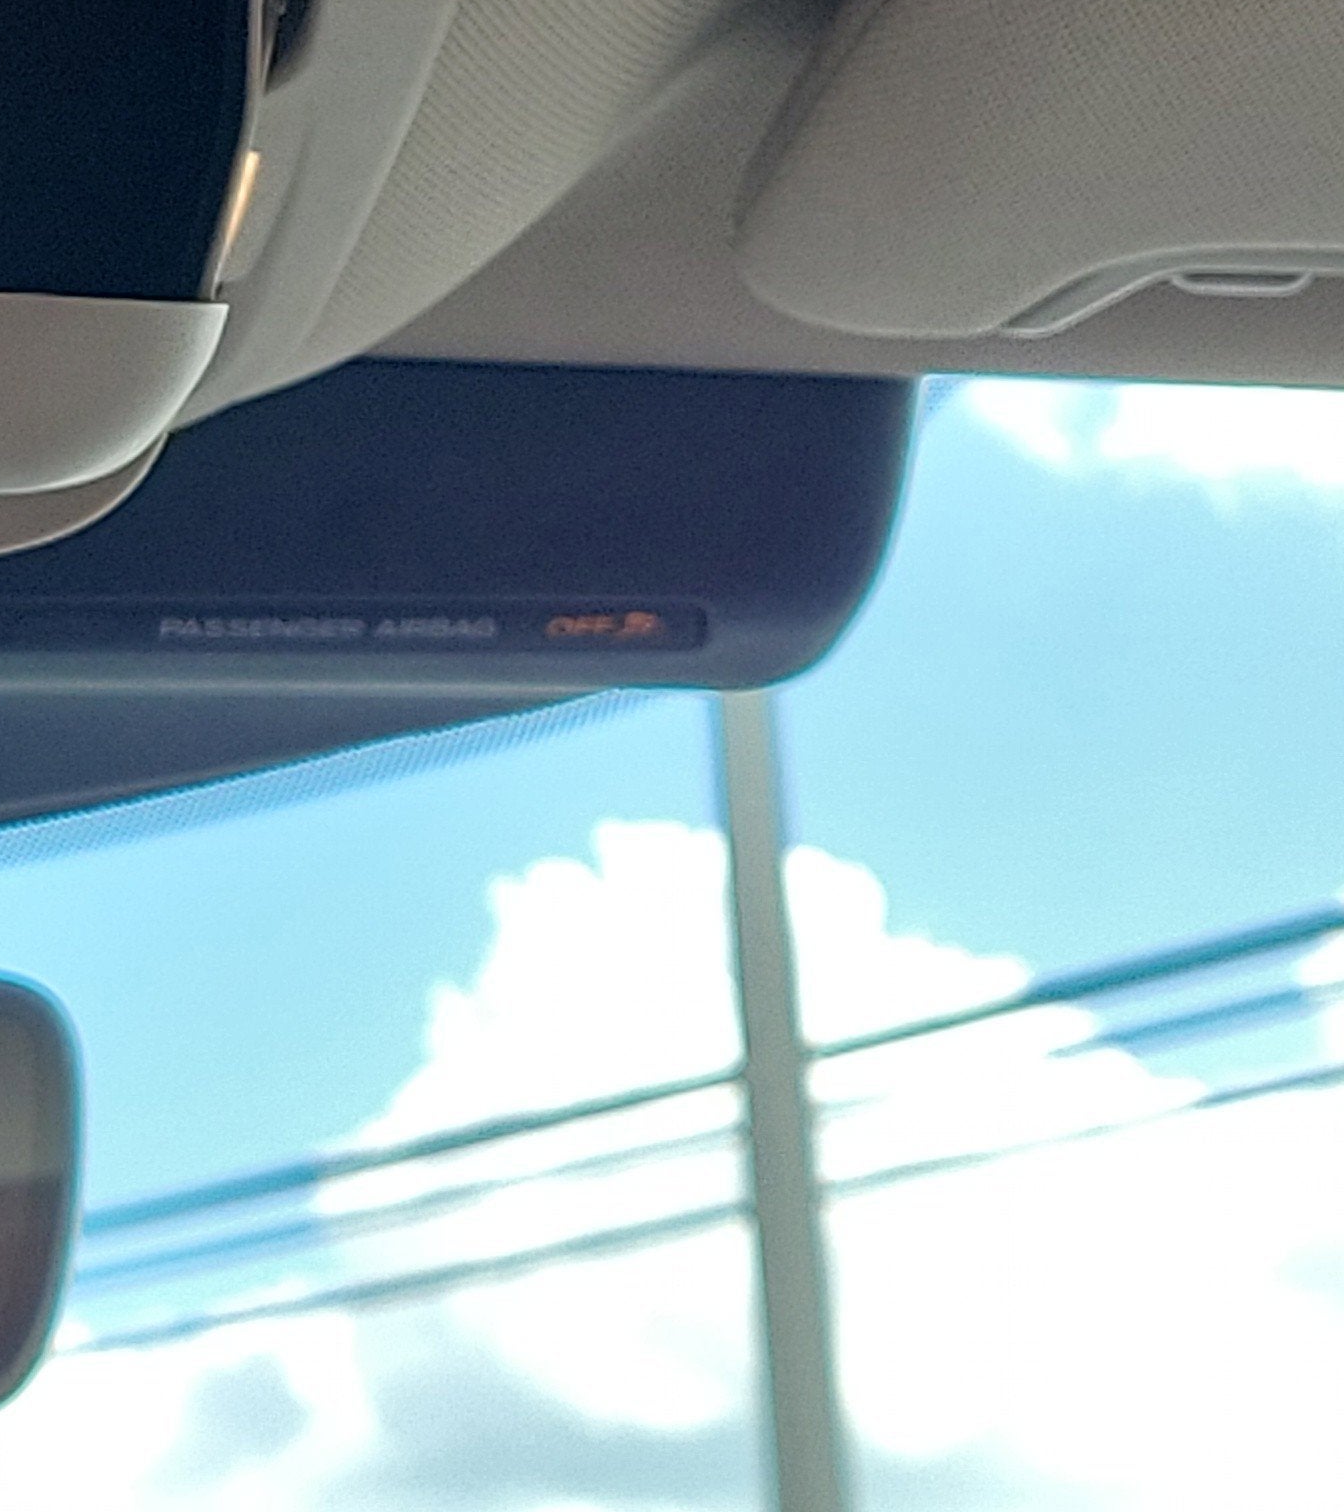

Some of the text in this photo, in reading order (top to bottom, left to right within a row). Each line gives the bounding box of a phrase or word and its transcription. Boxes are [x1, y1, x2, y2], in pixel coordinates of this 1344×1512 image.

[159, 614, 614, 637] PASSENGER AIRBAG OFF
